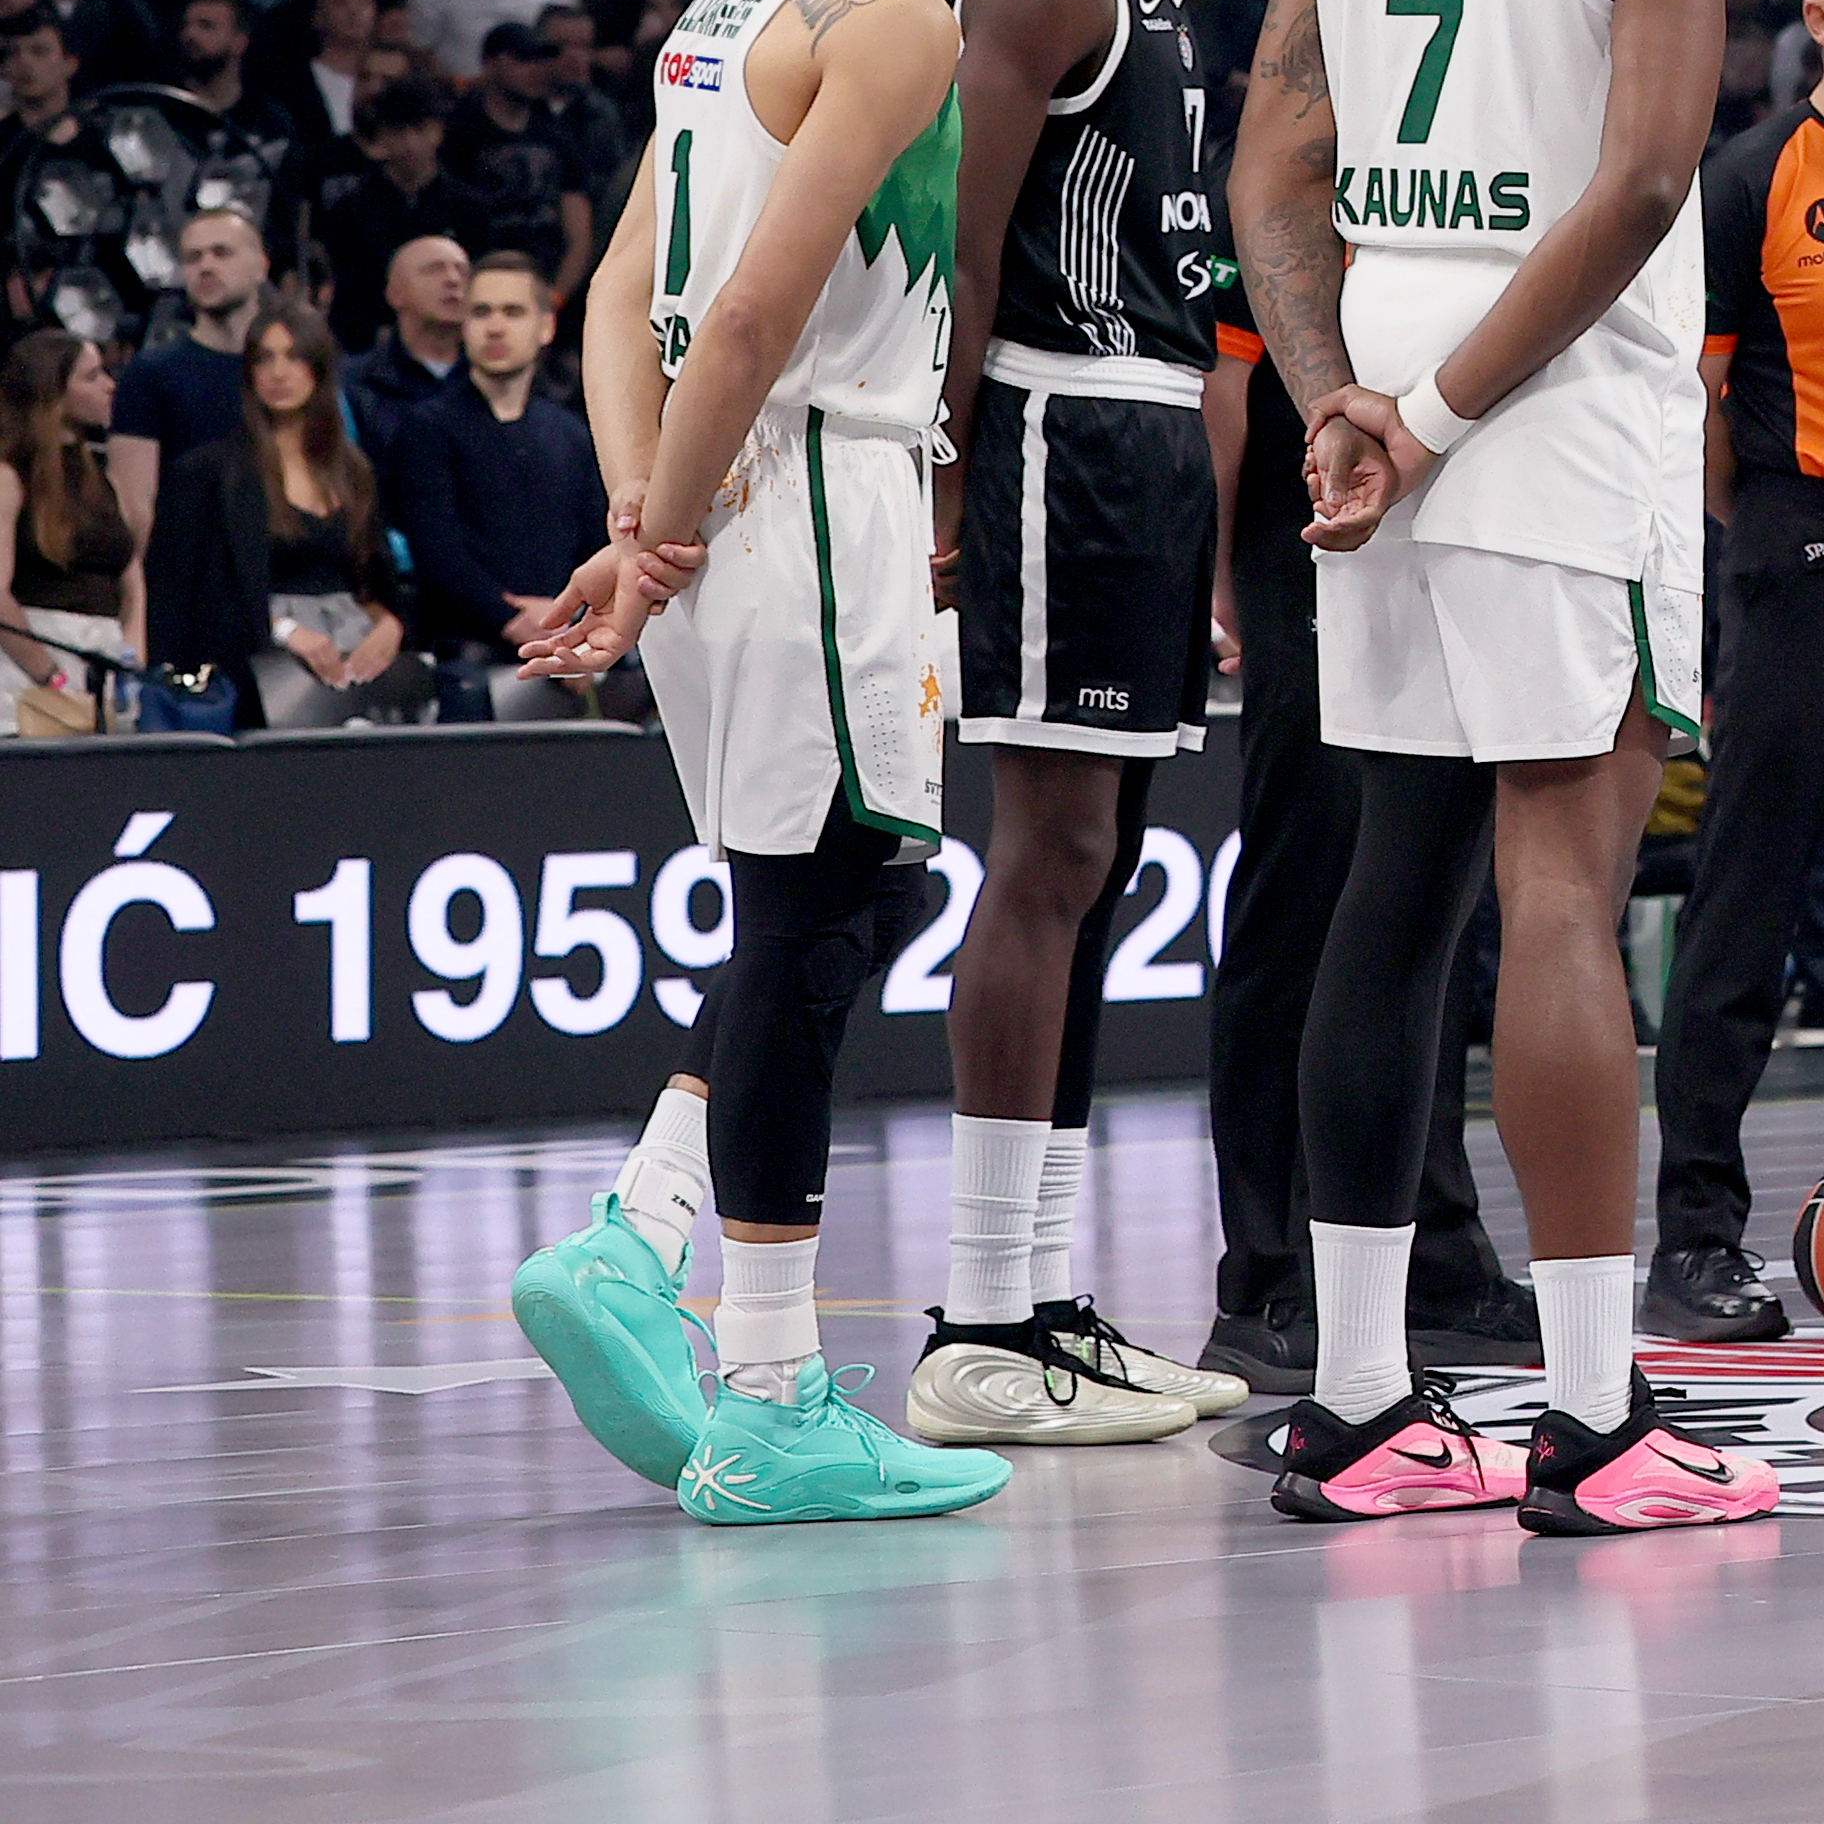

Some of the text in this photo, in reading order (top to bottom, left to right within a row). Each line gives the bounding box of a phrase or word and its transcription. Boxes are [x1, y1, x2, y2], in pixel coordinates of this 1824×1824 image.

[1182, 88, 1206, 173] 7
[671, 128, 693, 297] 1
[1334, 166, 1531, 232] KAUNAS
[1078, 686, 1130, 712] mts
